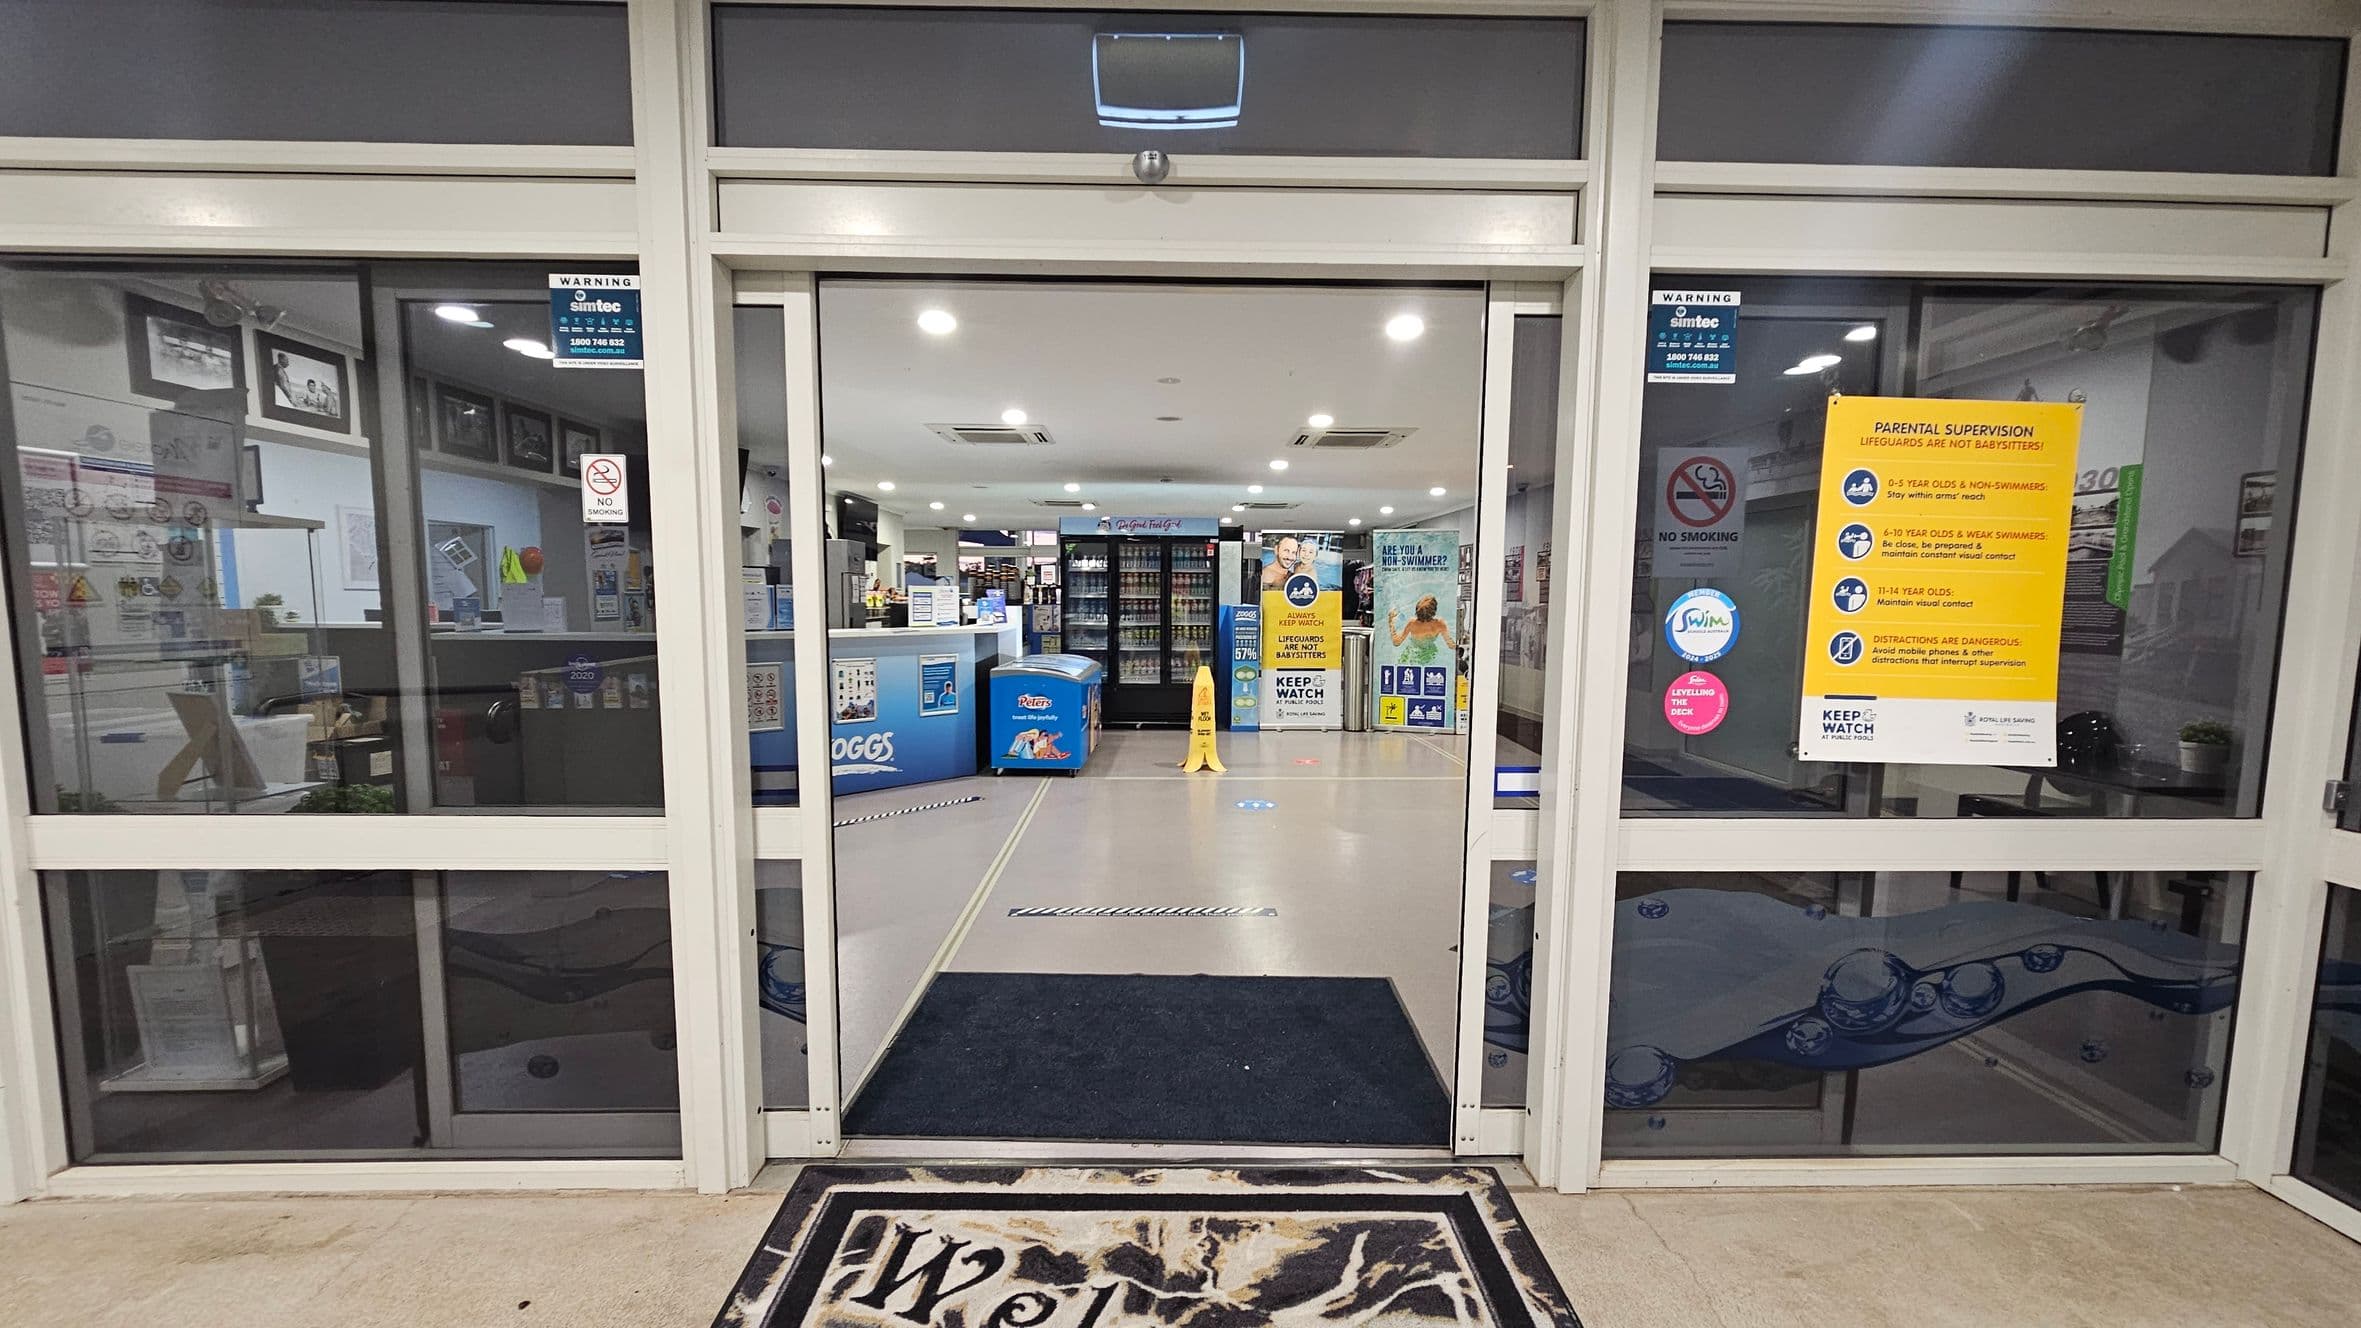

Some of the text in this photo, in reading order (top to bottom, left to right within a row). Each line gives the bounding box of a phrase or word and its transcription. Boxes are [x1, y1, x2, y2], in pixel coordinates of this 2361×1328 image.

[559, 277, 631, 287] WARNING
[1662, 293, 1732, 303] WARNING
[570, 299, 621, 312] simtec
[1670, 315, 1719, 328] simtec
[1874, 421, 2034, 438] PARENTAL SUPERVISION
[1860, 436, 2044, 451] LIFEGUARDS ARE NOT BABYSITTERS!
[2074, 466, 2119, 491] 30
[1888, 479, 2048, 491] 0-5 YEAR OLDS & NON-SWIMMERS:
[1887, 490, 1905, 500] Stay
[1908, 491, 1933, 499] within
[1961, 493, 1985, 501] reach
[597, 498, 613, 506] NO
[1658, 531, 1739, 543] NO SMOKING
[1883, 528, 1902, 537] 6-10
[1906, 529, 1927, 538] YEAR
[1930, 530, 1954, 538] OLDS
[1956, 530, 1963, 538] &
[1967, 531, 1993, 539] WEAK
[1382, 545, 1422, 555] ARE YOU A
[1882, 540, 1893, 548] Be
[1921, 541, 1932, 549] be
[1934, 541, 1973, 551] prepared
[1382, 555, 1448, 566] NON-SWIMMER?
[1881, 550, 2016, 561] maintain constant visual contact
[1687, 589, 1720, 598] MEMBER
[1878, 587, 1954, 597] 11-14 YEAR OLDS:
[1877, 599, 1973, 608] Maintain visual contact
[1235, 610, 1257, 619] ZOGGS
[1675, 607, 1729, 632] Swim
[1278, 635, 1324, 643] LIFEGUARDS
[1873, 635, 2022, 647] DISTRACTIONS ARE DANGEROUS:
[1235, 647, 1257, 660] 57%
[1276, 651, 1326, 659] BABYSITTERS
[1872, 647, 1994, 657] Avoid mobile phones & other
[1871, 656, 2026, 668] distractions that interrupt supervision
[570, 671, 594, 680] 2020
[1276, 676, 1311, 687] KEEP
[1276, 688, 1324, 699] WATCH
[1671, 688, 1716, 697] LEVELLING
[1019, 695, 1052, 707] Peters
[1671, 698, 1688, 706] THE
[1670, 708, 1694, 716] DECK
[1823, 709, 1861, 721] KEEP
[1822, 722, 1875, 734] WATCH
[832, 731, 894, 762] OGGS
